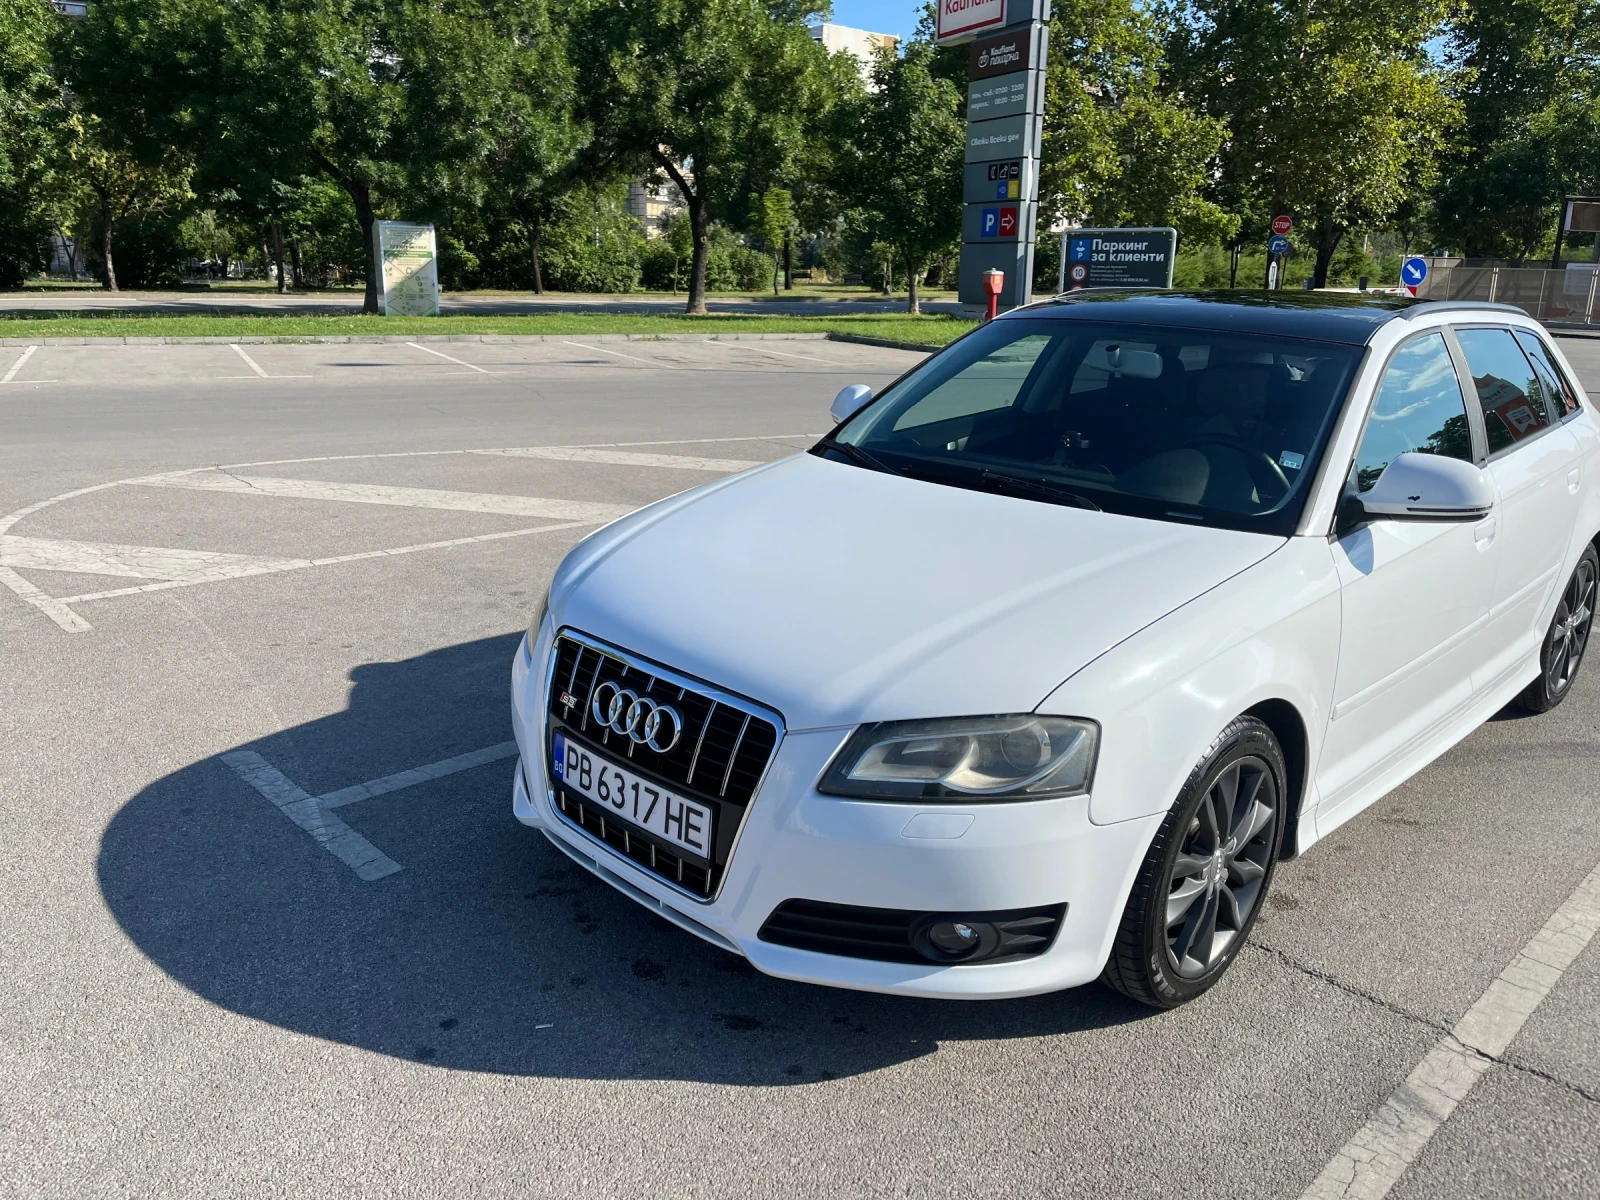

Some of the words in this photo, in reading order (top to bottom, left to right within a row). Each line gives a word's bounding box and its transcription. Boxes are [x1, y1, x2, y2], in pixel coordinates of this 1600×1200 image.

[990, 42, 1016, 56] Kaufland
[985, 214, 995, 231] P
[1274, 221, 1290, 229] STOP
[1092, 239, 1149, 253] Паркинг
[1091, 253, 1106, 262] за
[1109, 252, 1165, 262] клиенти
[1074, 268, 1084, 278] 10
[554, 760, 563, 774] BG
[565, 744, 593, 792] PB
[597, 765, 660, 824] 6317
[664, 796, 704, 850] HE
